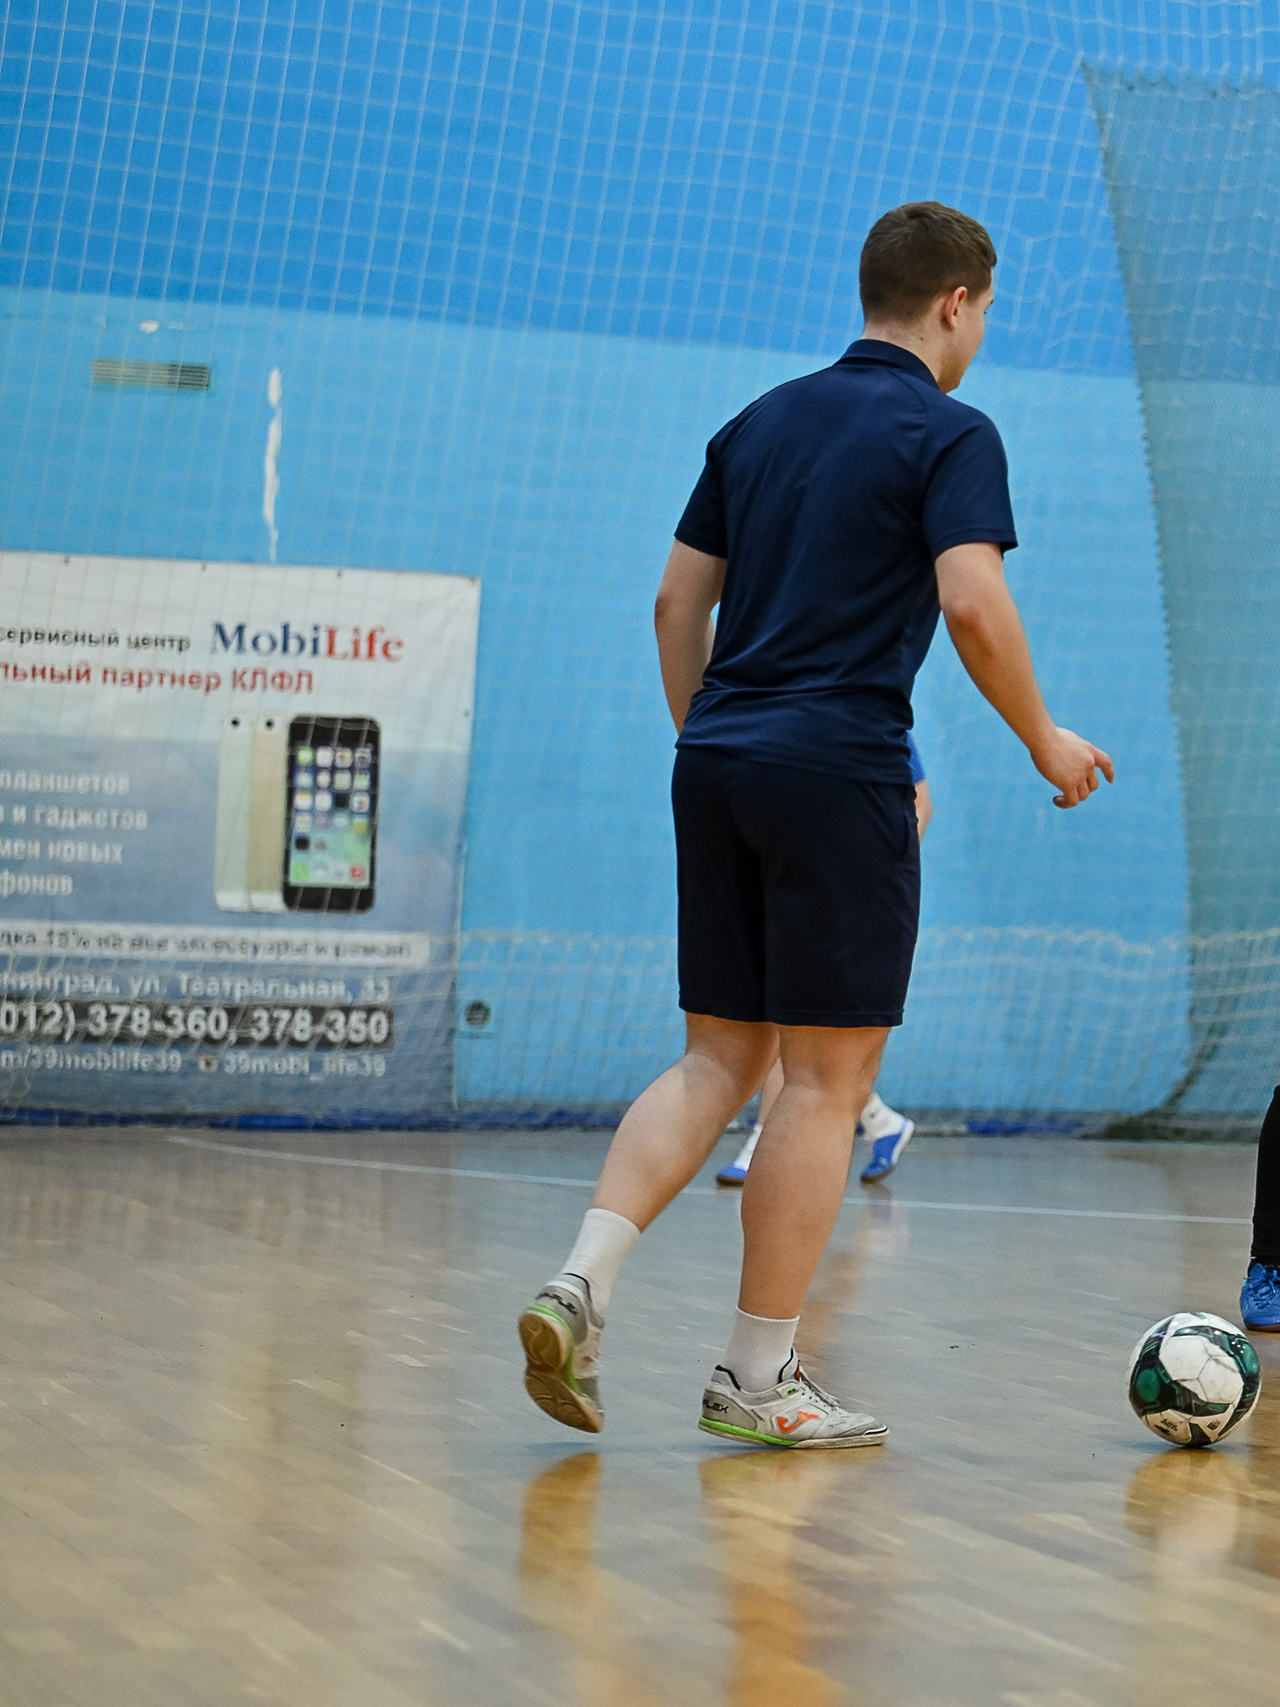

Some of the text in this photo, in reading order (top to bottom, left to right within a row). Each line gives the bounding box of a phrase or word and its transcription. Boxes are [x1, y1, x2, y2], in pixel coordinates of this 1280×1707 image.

[127, 633, 191, 653] центр
[209, 621, 405, 664] MobiLife
[102, 667, 222, 696] партнер
[34, 804, 148, 831] гаджетов
[47, 839, 123, 864] новых
[0, 1001, 76, 1043] 012)
